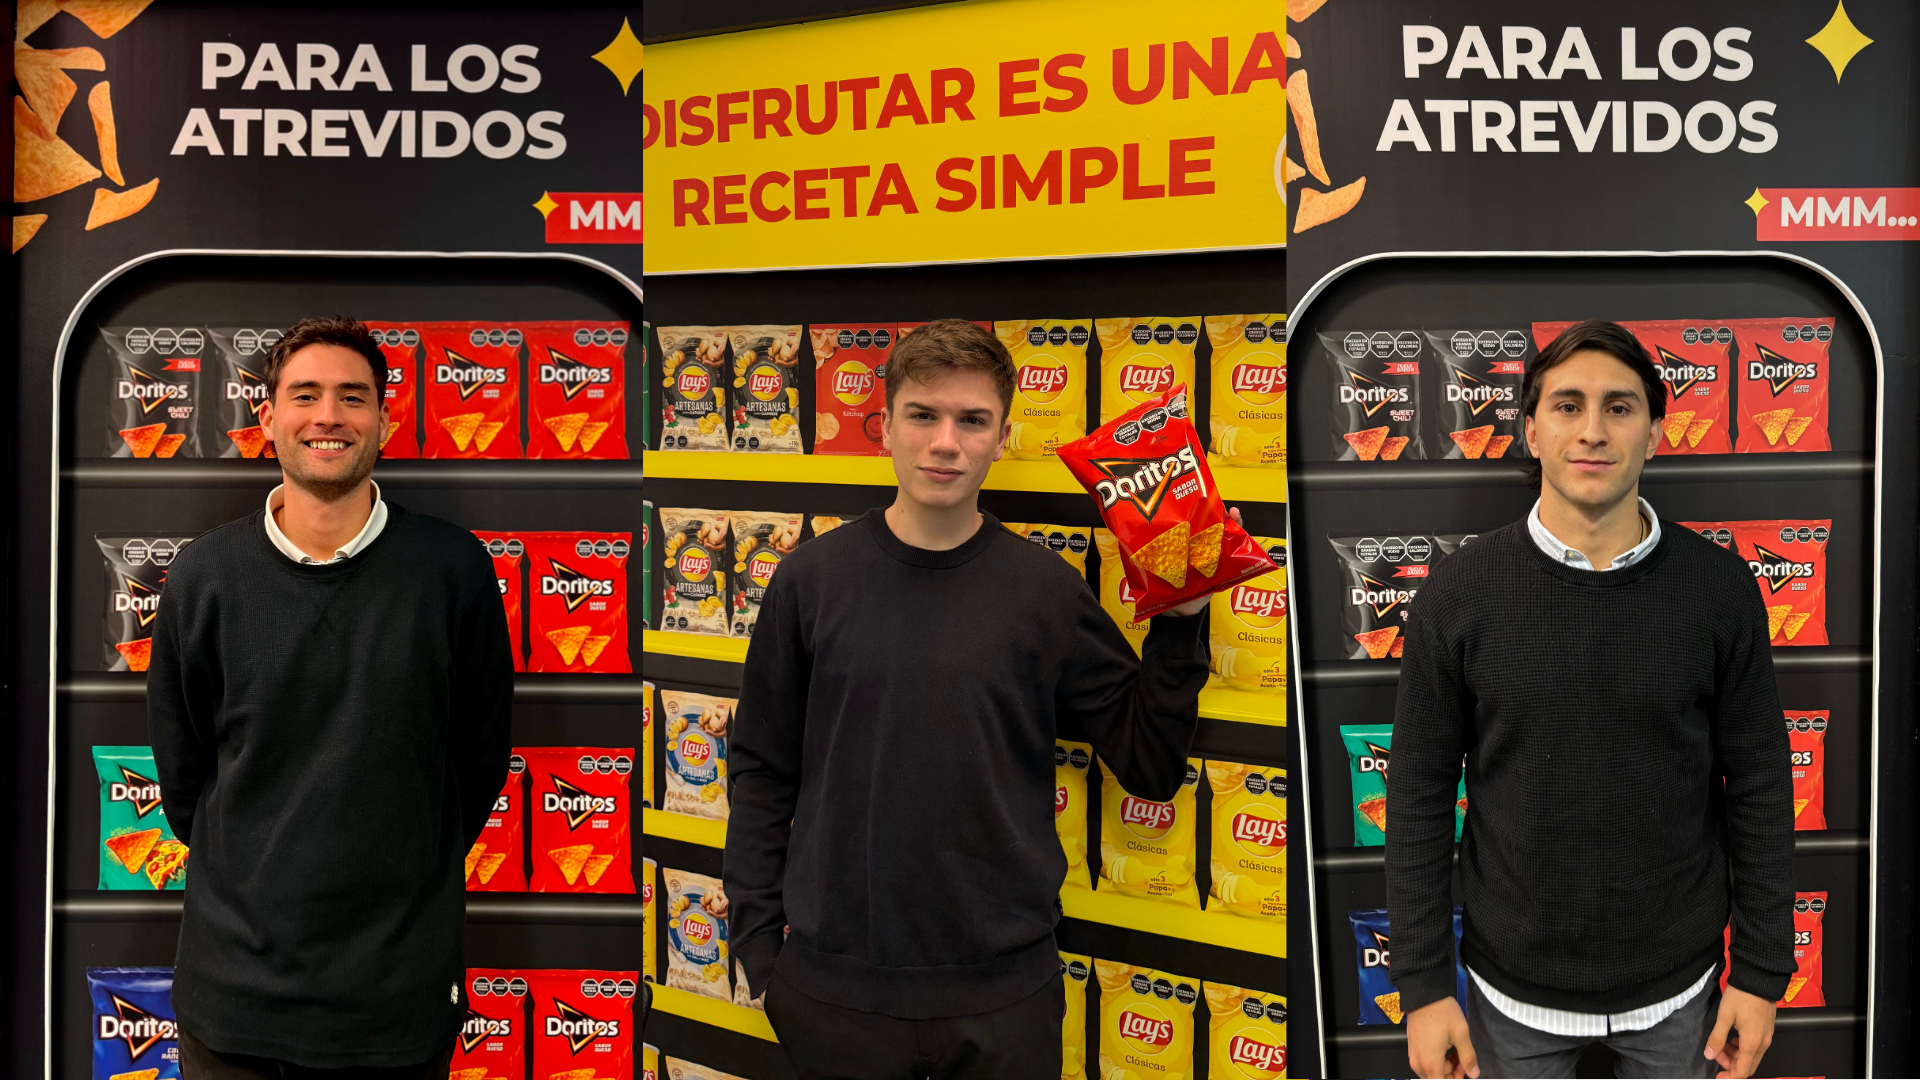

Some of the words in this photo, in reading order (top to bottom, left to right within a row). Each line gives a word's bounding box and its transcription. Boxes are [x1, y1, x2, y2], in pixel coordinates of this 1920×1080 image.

[1402, 24, 1602, 80] PARA
[1621, 26, 1754, 82] LOS
[201, 42, 392, 91] PARA
[411, 44, 542, 93] LOS
[999, 53, 1088, 117] ES
[1112, 31, 1287, 105] UNA
[170, 108, 567, 160] ATREVIDOS
[1375, 98, 1779, 153] ATREVIDOS
[673, 163, 919, 227] RECETA
[935, 136, 1216, 213] SIMPLE
[1781, 196, 1918, 227] MMM...
[437, 365, 506, 383] Doritos
[540, 365, 611, 383] Doritos
[1021, 366, 1065, 393] Lay's
[1123, 365, 1171, 393] Lay's
[1235, 364, 1287, 394] Lay's
[1749, 362, 1817, 379] Doritos
[118, 381, 188, 399] Doritos
[681, 374, 708, 393] Lay's
[752, 374, 780, 393] Lay's
[836, 371, 872, 395] Lay's
[1340, 386, 1409, 403] Doritos
[1446, 384, 1514, 402] Doritos
[675, 401, 713, 411] ARTESANAS
[746, 402, 786, 412] ARTESANAS
[1023, 408, 1061, 417] Clásicas
[1238, 410, 1283, 420] Clásicas
[1094, 445, 1199, 510] Doritos
[1172, 478, 1196, 495] SABOR
[1175, 484, 1199, 500] QUESO
[682, 556, 709, 574] Lay's
[542, 576, 613, 595] Doritos
[675, 582, 714, 594] ARTESANAS
[1234, 586, 1287, 617] Lay's
[1237, 632, 1282, 644] Clásicas
[683, 741, 709, 760] Lay's
[678, 765, 714, 780] ARTESANAS
[111, 783, 161, 801] Dorit
[544, 793, 615, 812] Doritos
[1124, 797, 1173, 828] Lay's
[1236, 814, 1287, 846] Lay's
[1127, 841, 1168, 855] Clásicas
[1239, 859, 1283, 874] Clásicas
[1149, 883, 1168, 891] Papa
[1262, 903, 1282, 912] Papa
[685, 919, 711, 940] Lay's
[680, 943, 717, 961] ARTESANAS
[462, 1018, 510, 1035] oritos
[546, 1017, 618, 1036] Doritos
[1122, 1011, 1171, 1044] Lay's
[1232, 1036, 1287, 1070] Lay's
[1125, 1054, 1166, 1072] Clásicas
